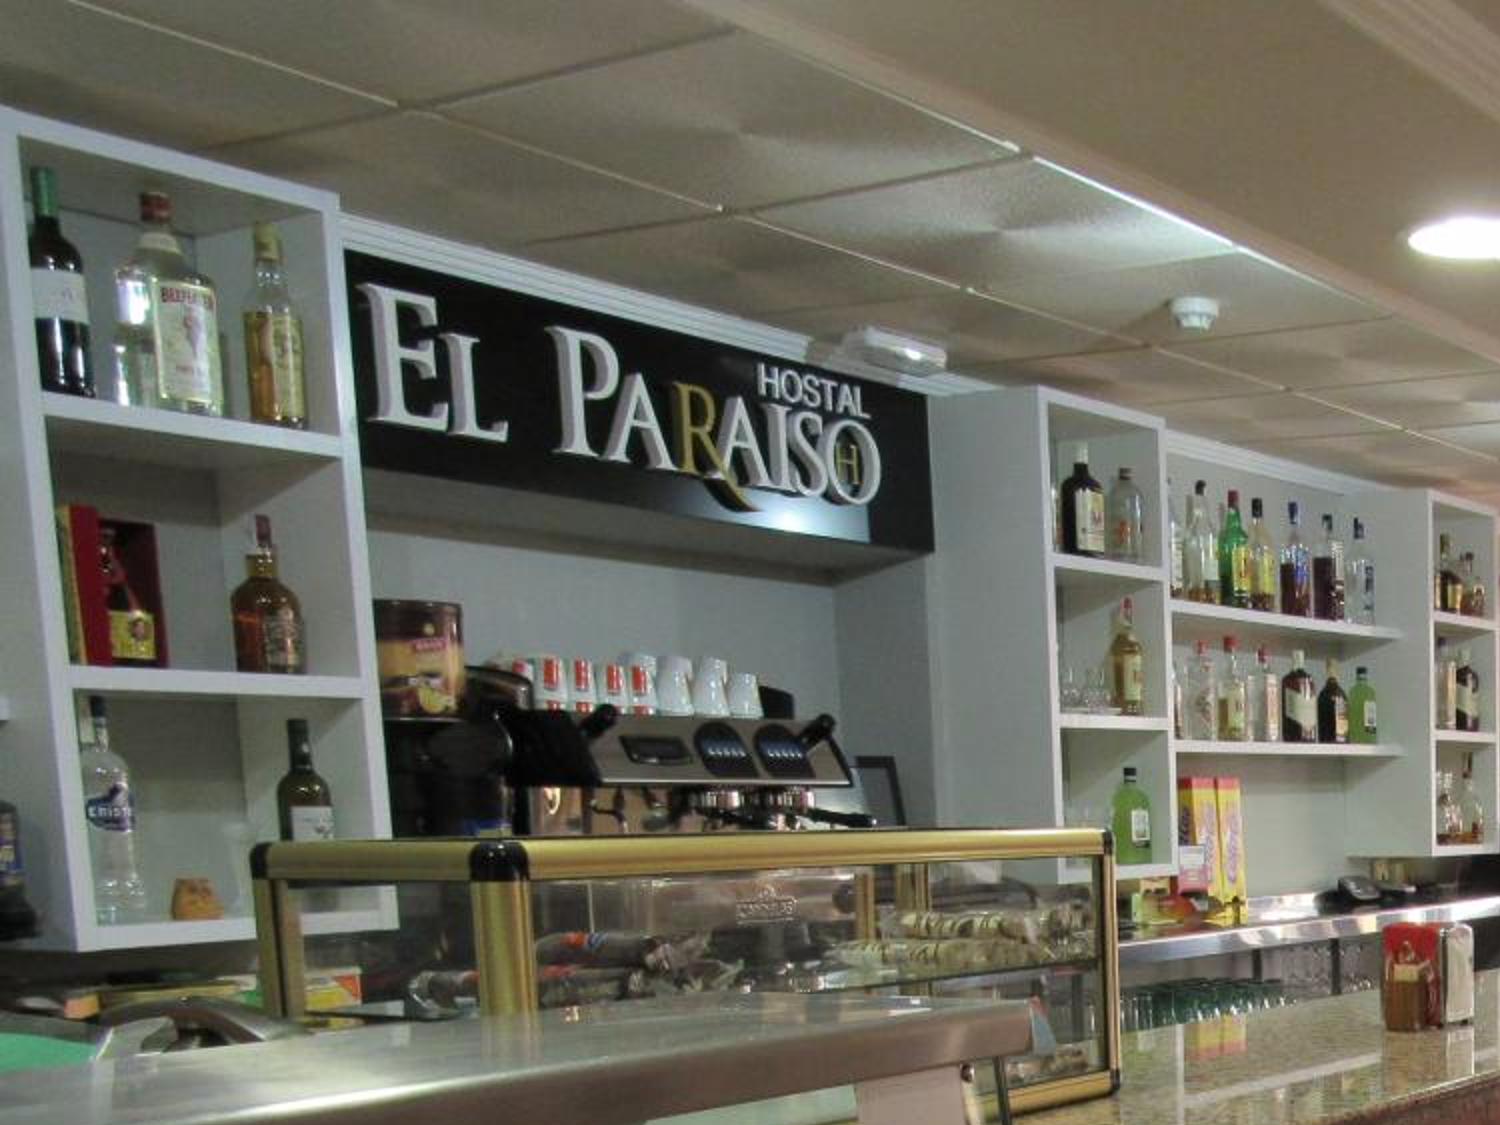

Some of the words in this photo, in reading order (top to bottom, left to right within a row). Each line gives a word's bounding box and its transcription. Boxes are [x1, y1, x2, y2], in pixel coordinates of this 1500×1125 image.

[355, 283, 509, 443] EL
[544, 325, 881, 511] PARAISO
[756, 362, 872, 419] HOSTAL
